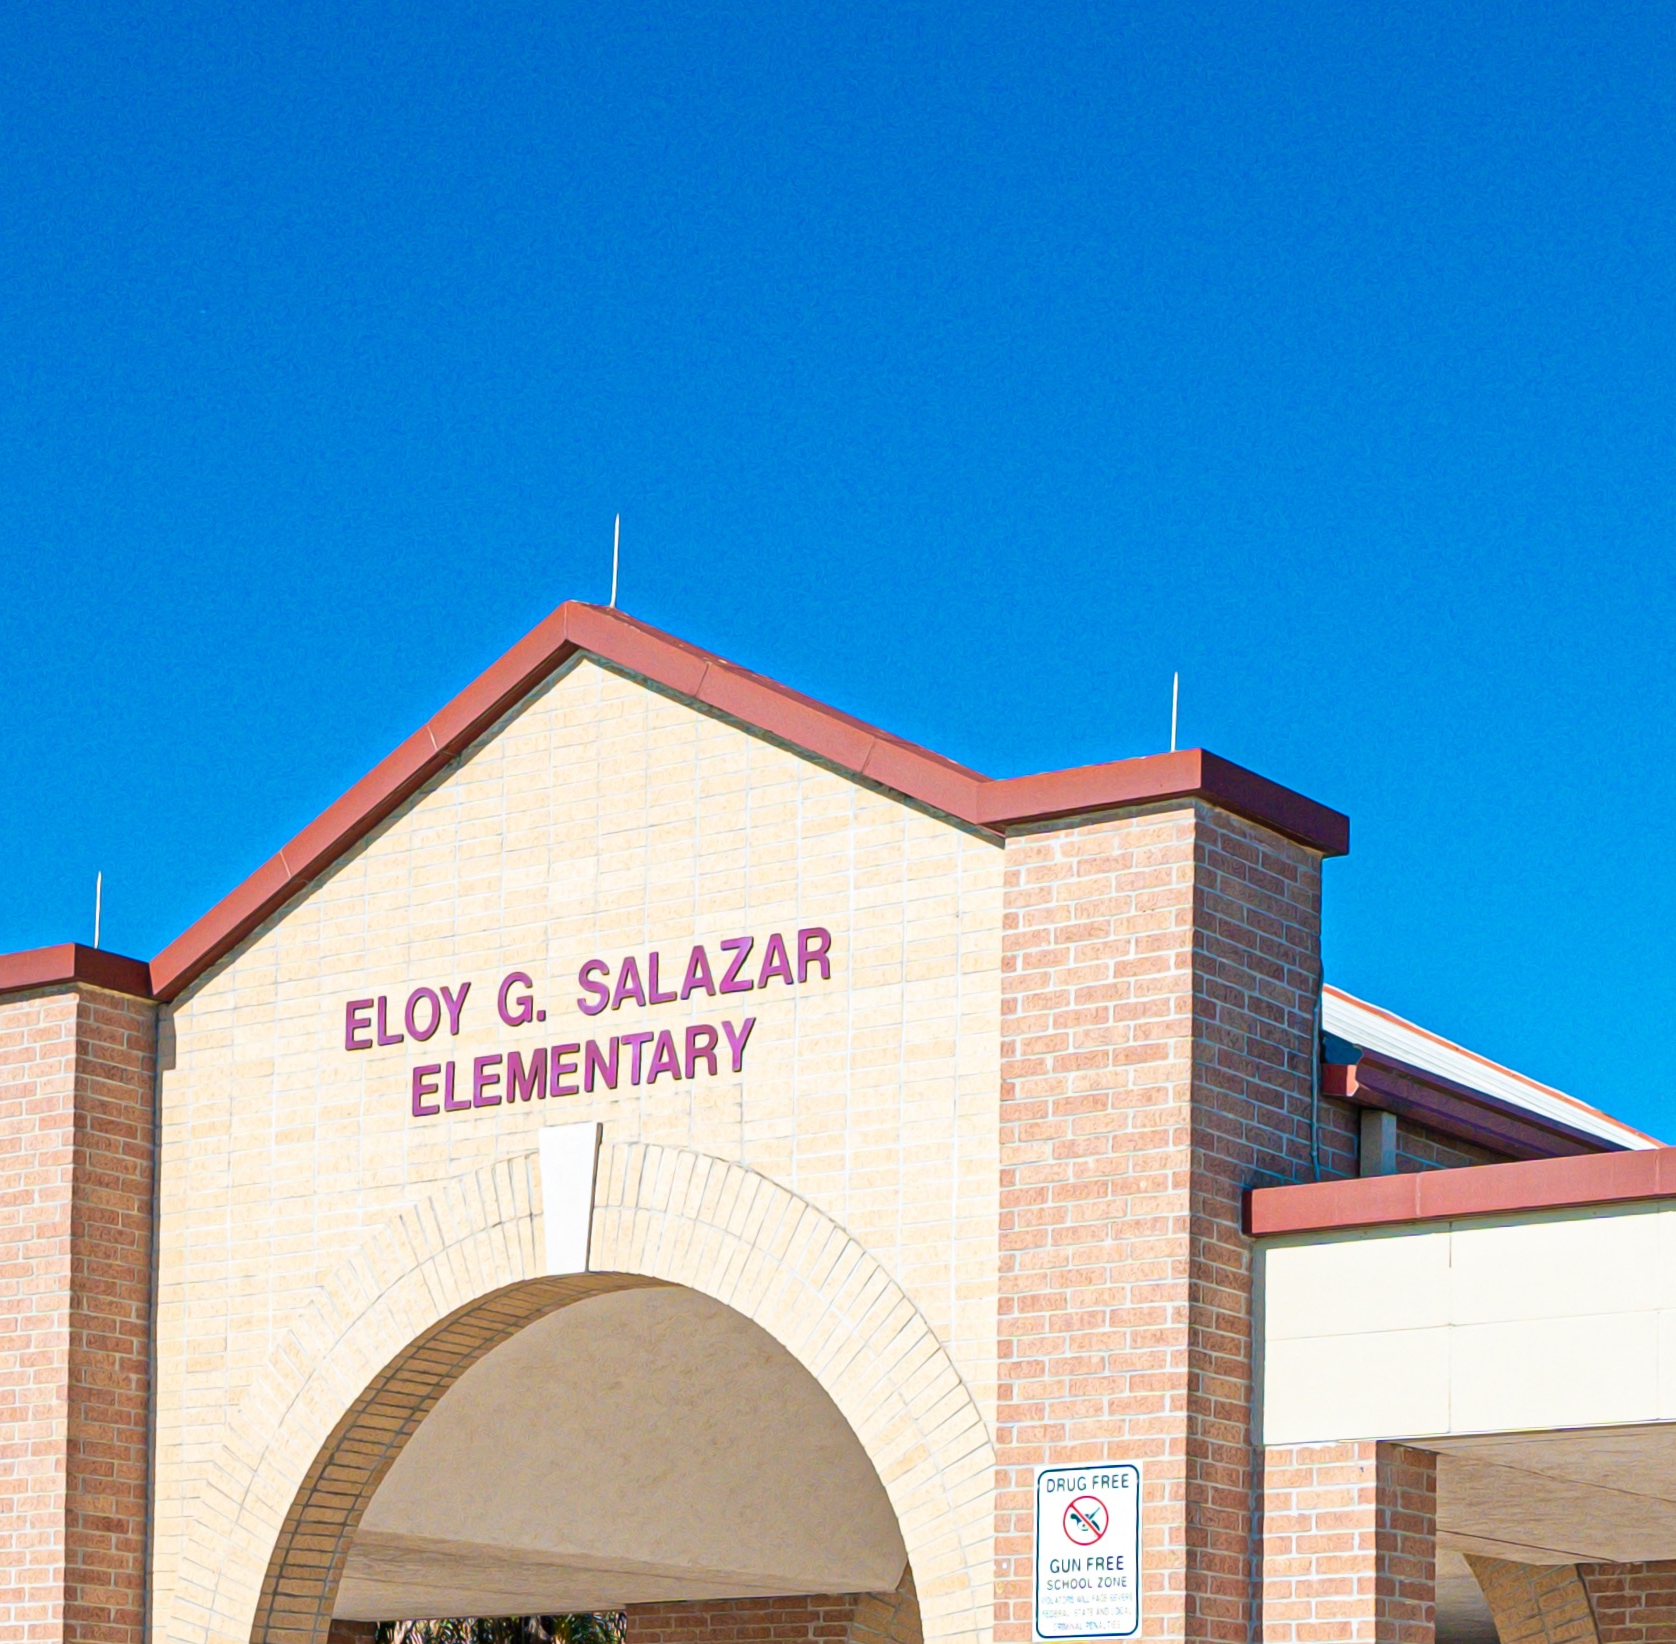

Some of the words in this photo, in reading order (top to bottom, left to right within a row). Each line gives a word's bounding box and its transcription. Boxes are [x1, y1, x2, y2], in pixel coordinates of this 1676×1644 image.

[345, 981, 471, 1051] ELOY
[497, 971, 547, 1027] G.
[577, 926, 832, 1016] SALAZAR
[412, 1017, 756, 1117] ELEMENTARY
[1046, 1476, 1087, 1493] DRUG
[1092, 1473, 1129, 1490] FREE
[1049, 1558, 1081, 1574] GUN
[1086, 1555, 1124, 1571] FREE
[1046, 1578, 1093, 1591] SCHOOL
[1097, 1576, 1127, 1588] ZONE
